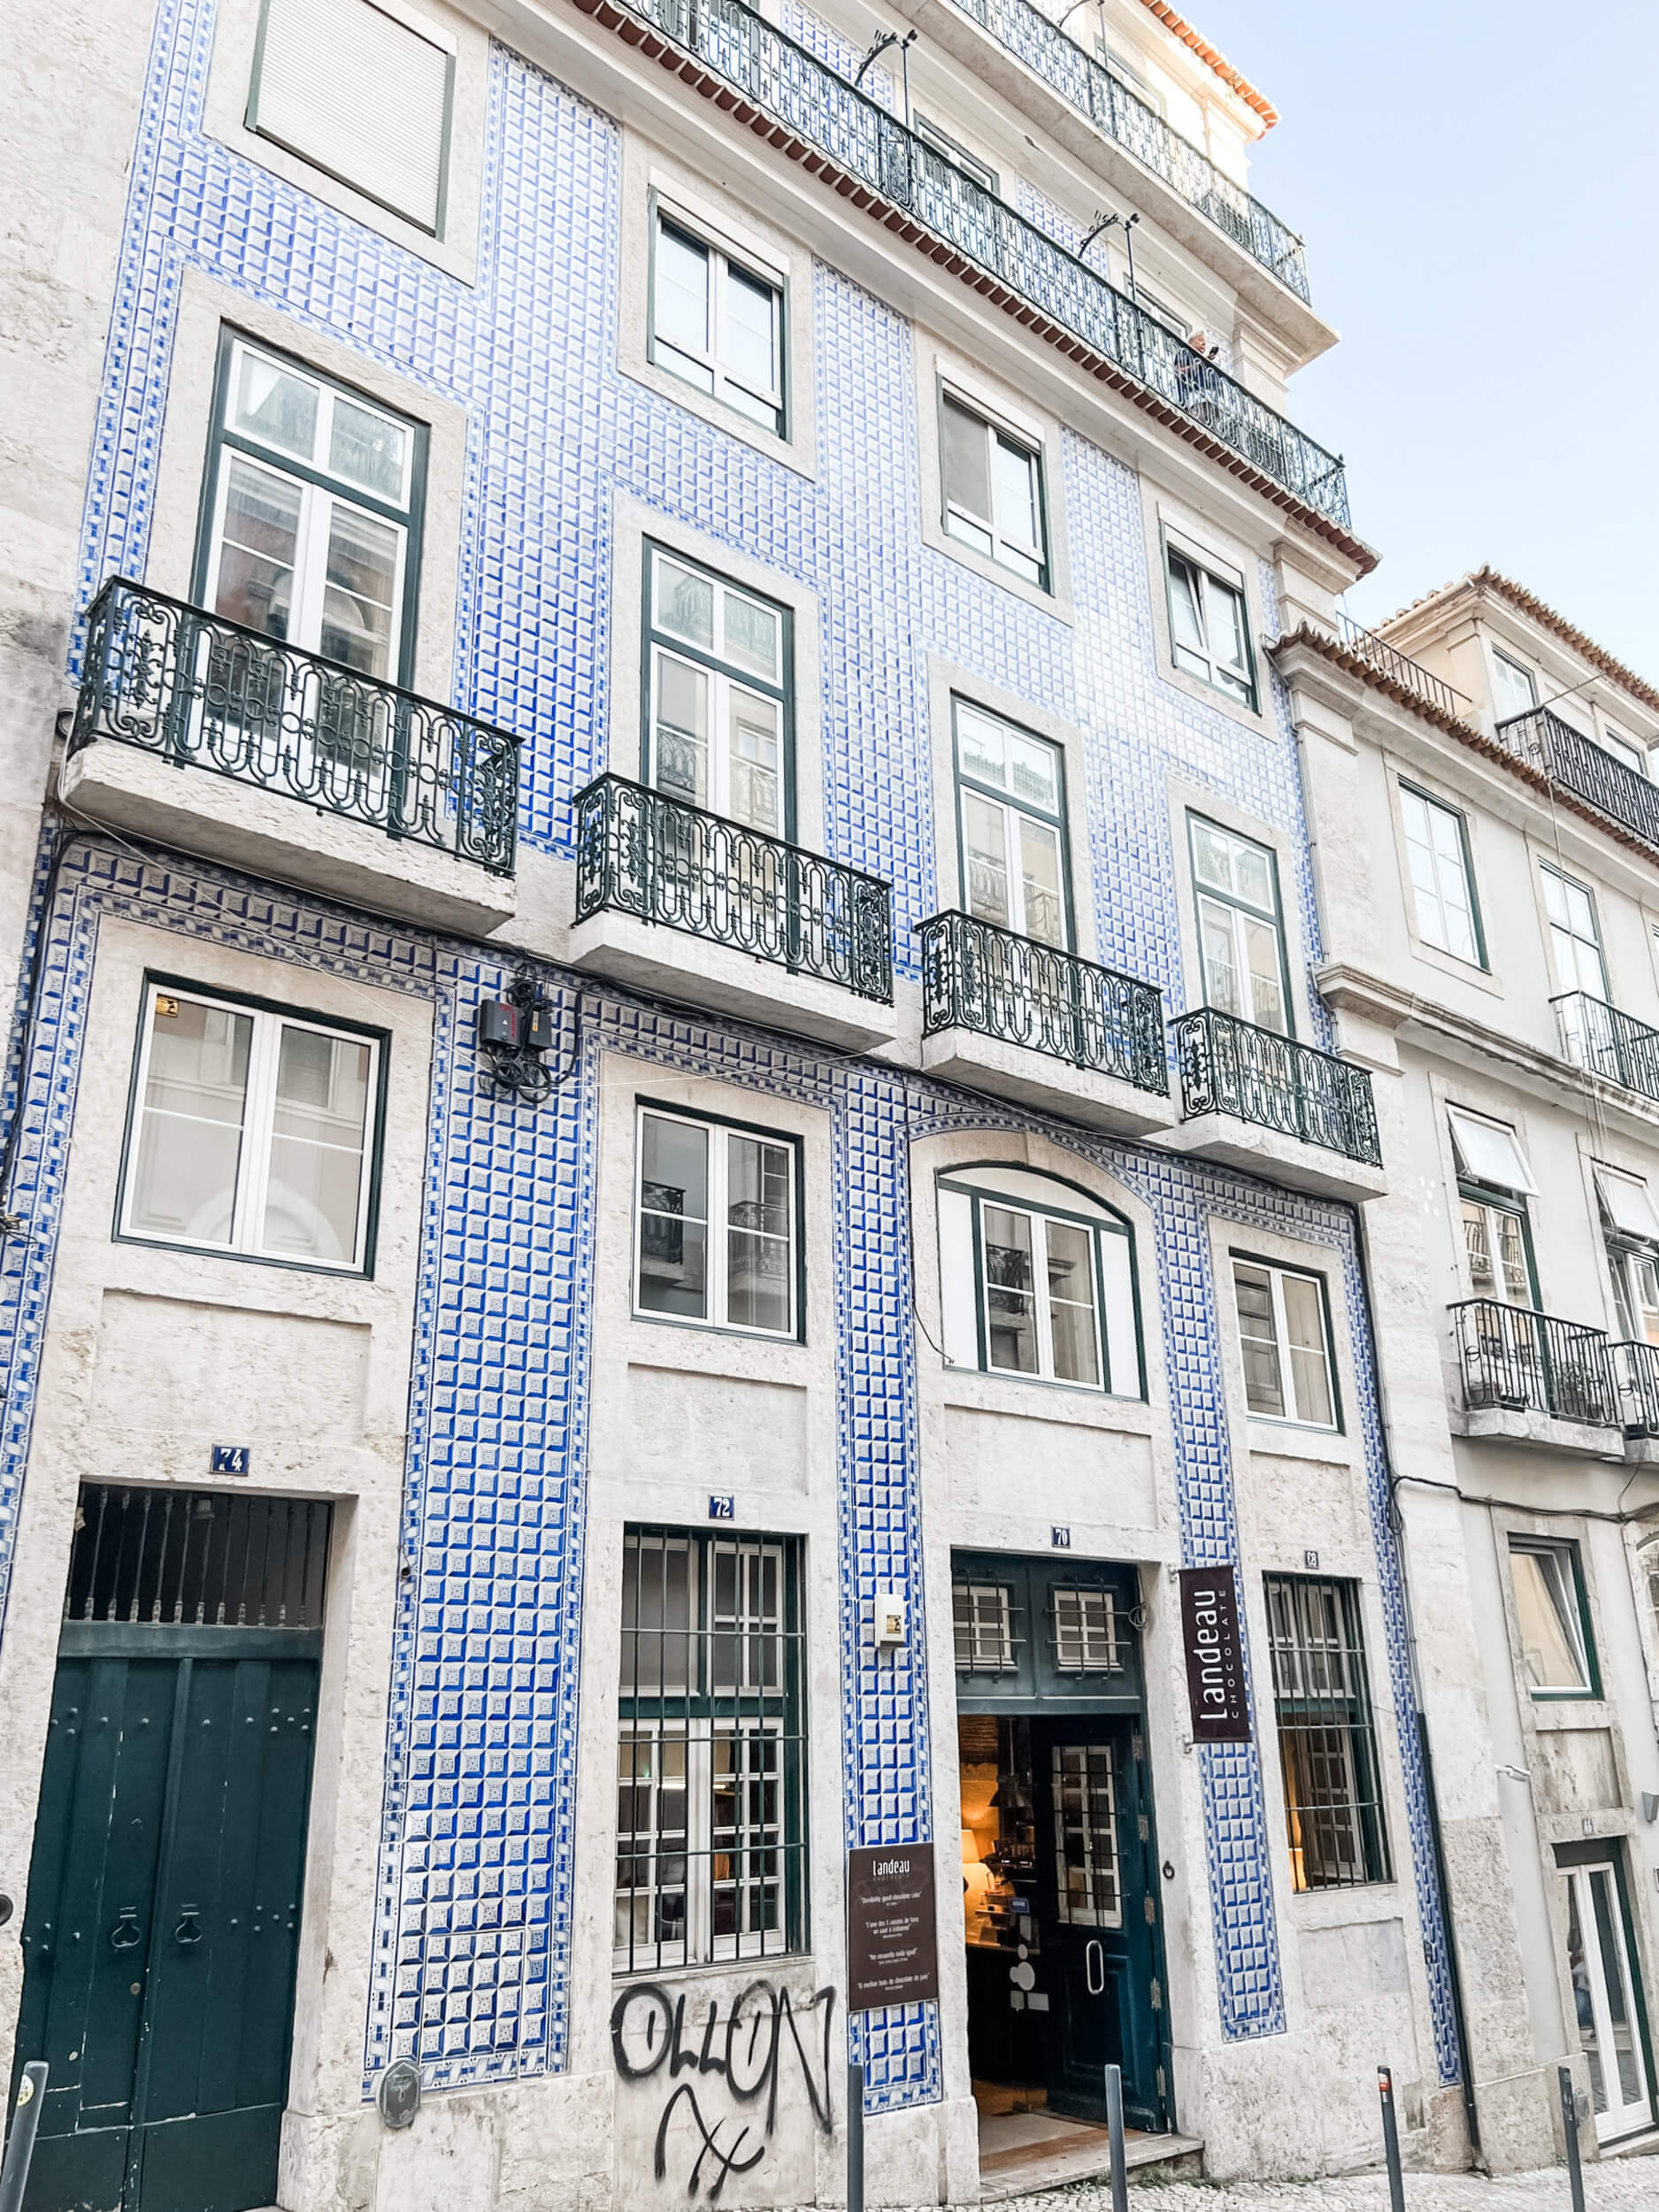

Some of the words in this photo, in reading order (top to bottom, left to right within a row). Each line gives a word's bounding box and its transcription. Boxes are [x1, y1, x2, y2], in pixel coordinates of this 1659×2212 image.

[219, 1448, 243, 1472] 74
[714, 1496, 731, 1517] 72
[1055, 1528, 1069, 1545] 70
[1218, 1589, 1240, 1719] CHOCOLATE
